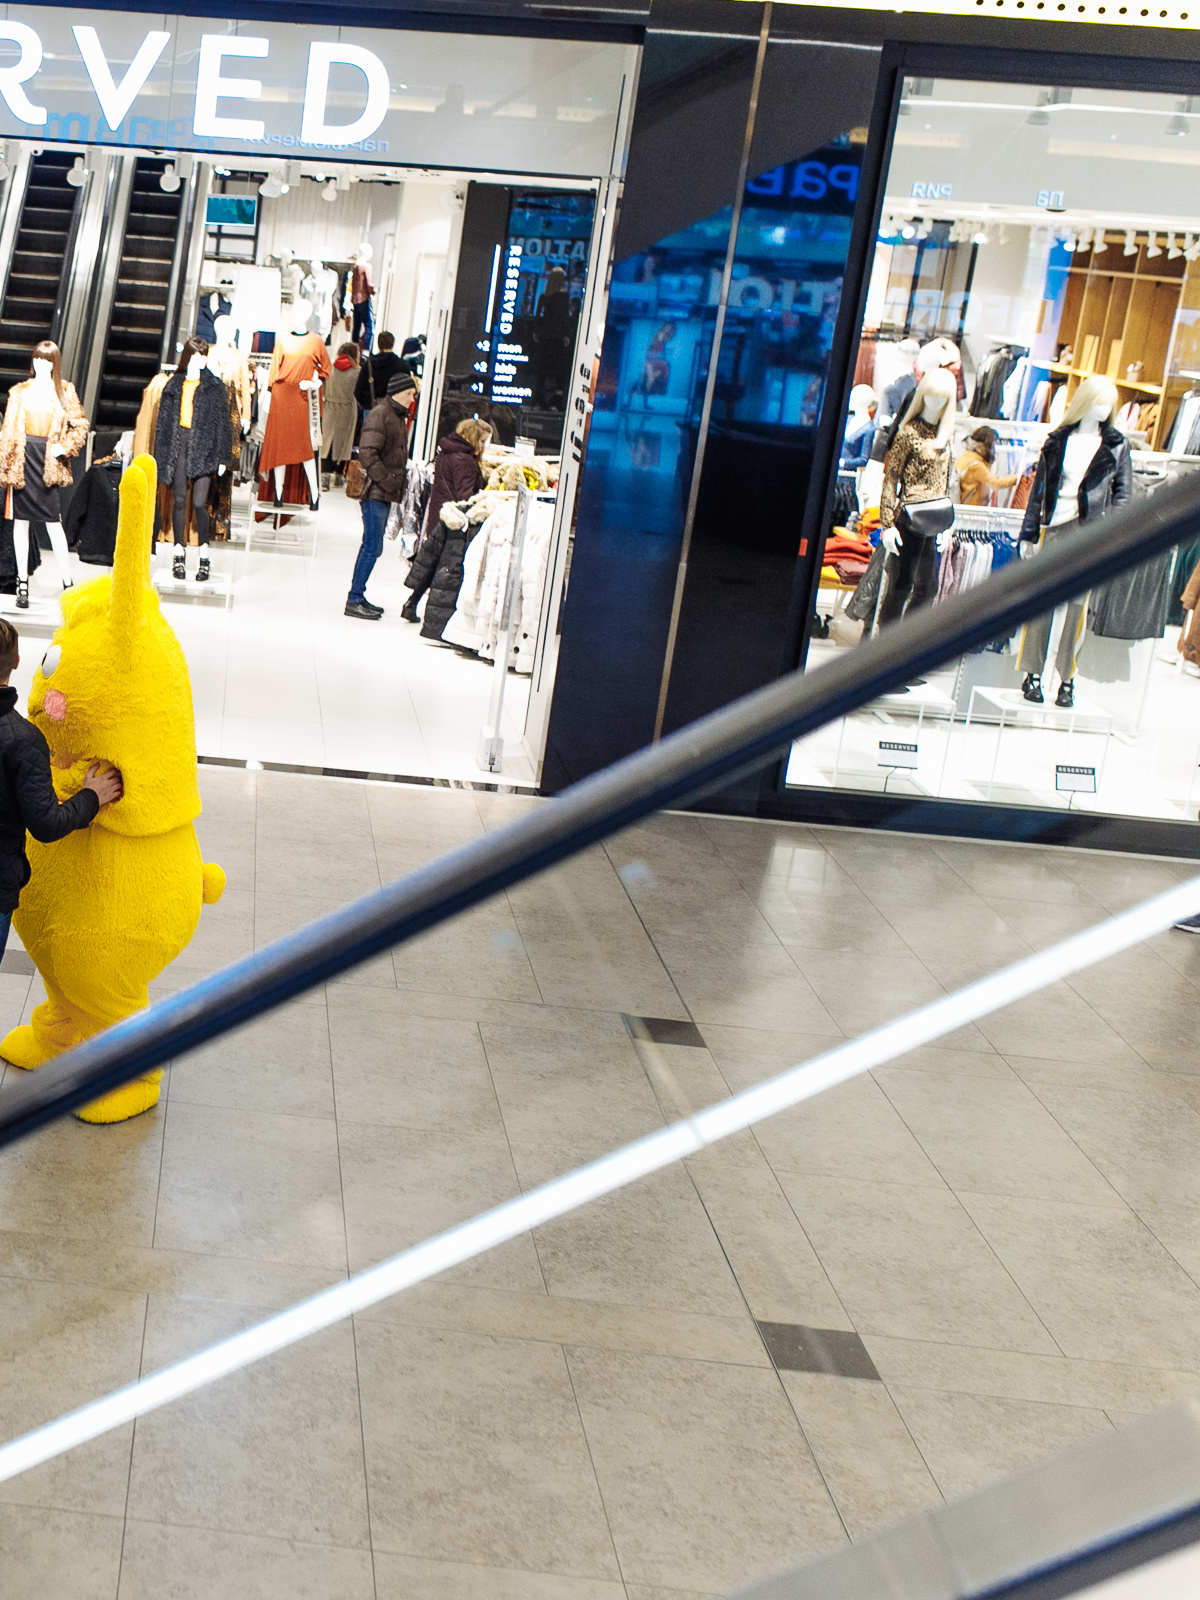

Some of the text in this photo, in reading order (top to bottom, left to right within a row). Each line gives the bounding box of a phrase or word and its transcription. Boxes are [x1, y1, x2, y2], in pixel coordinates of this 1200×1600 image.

[500, 245, 523, 335] RESERVED
[881, 742, 916, 751] RESERVED
[1057, 766, 1093, 775] RESERVED
